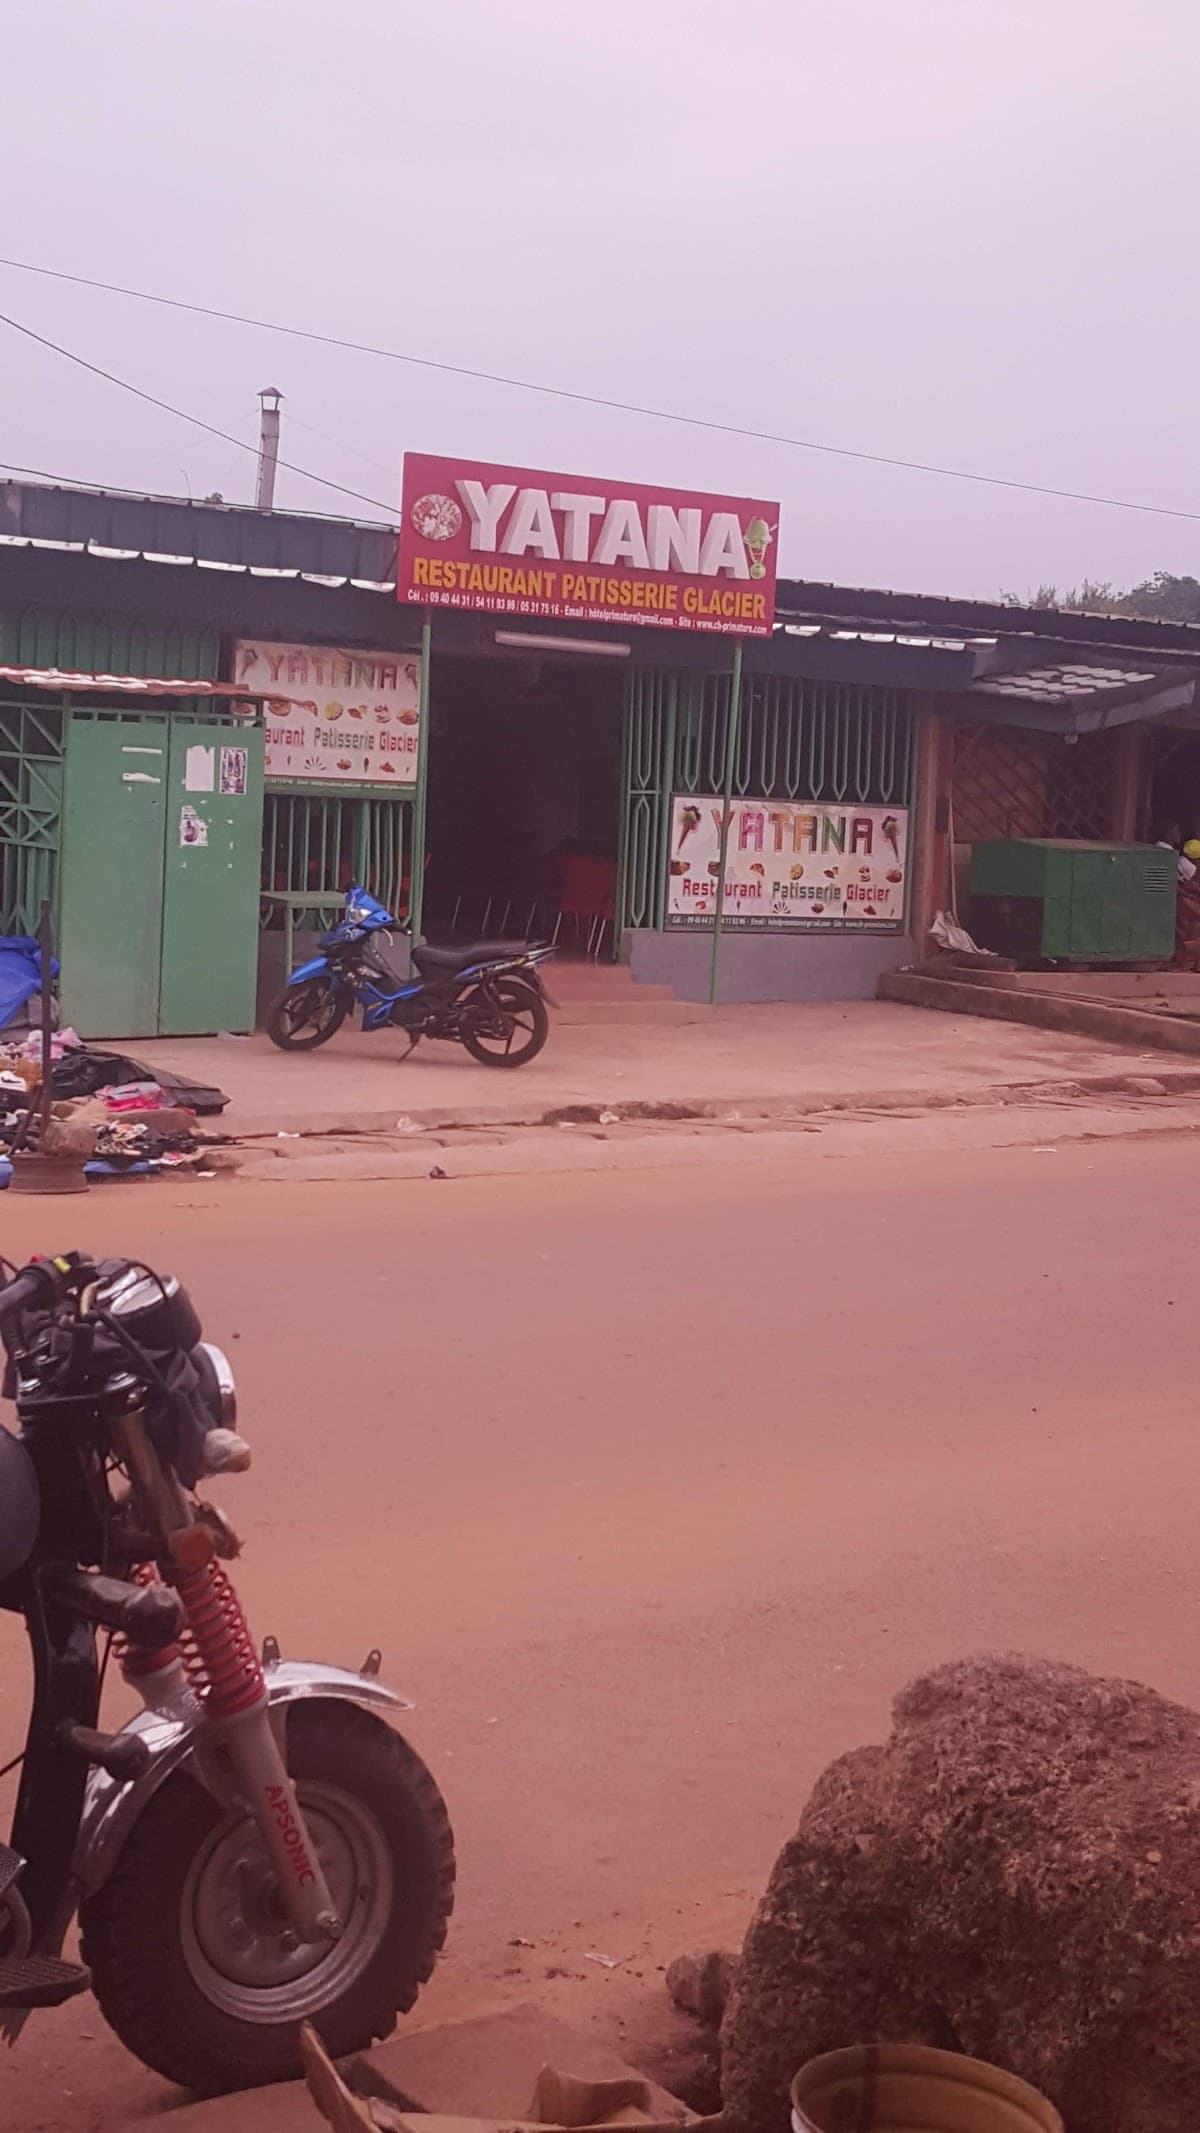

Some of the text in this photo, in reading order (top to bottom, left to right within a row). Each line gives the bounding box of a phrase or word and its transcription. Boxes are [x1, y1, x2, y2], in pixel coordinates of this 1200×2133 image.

[454, 479, 750, 580] YATANA
[413, 557, 766, 619] RESTAURANT PATISSERIE GLACIER
[430, 591, 440, 603] 09
[440, 592, 450, 604] 40
[450, 593, 460, 605] 44
[461, 594, 470, 606] 31
[476, 596, 485, 608] 54
[487, 597, 494, 609] 11
[520, 601, 529, 612] 05
[531, 601, 539, 613] 31
[541, 603, 550, 614] 75
[551, 604, 560, 615] 16
[564, 605, 584, 617] Email
[678, 616, 692, 628] Site
[264, 651, 398, 691] YATANA
[313, 727, 375, 750] Patisserie
[379, 731, 418, 753] Glacier
[710, 807, 874, 855] YATANA
[682, 878, 890, 902] Resturant Patisserie Glacier
[264, 1785, 315, 1887] APSONIC
